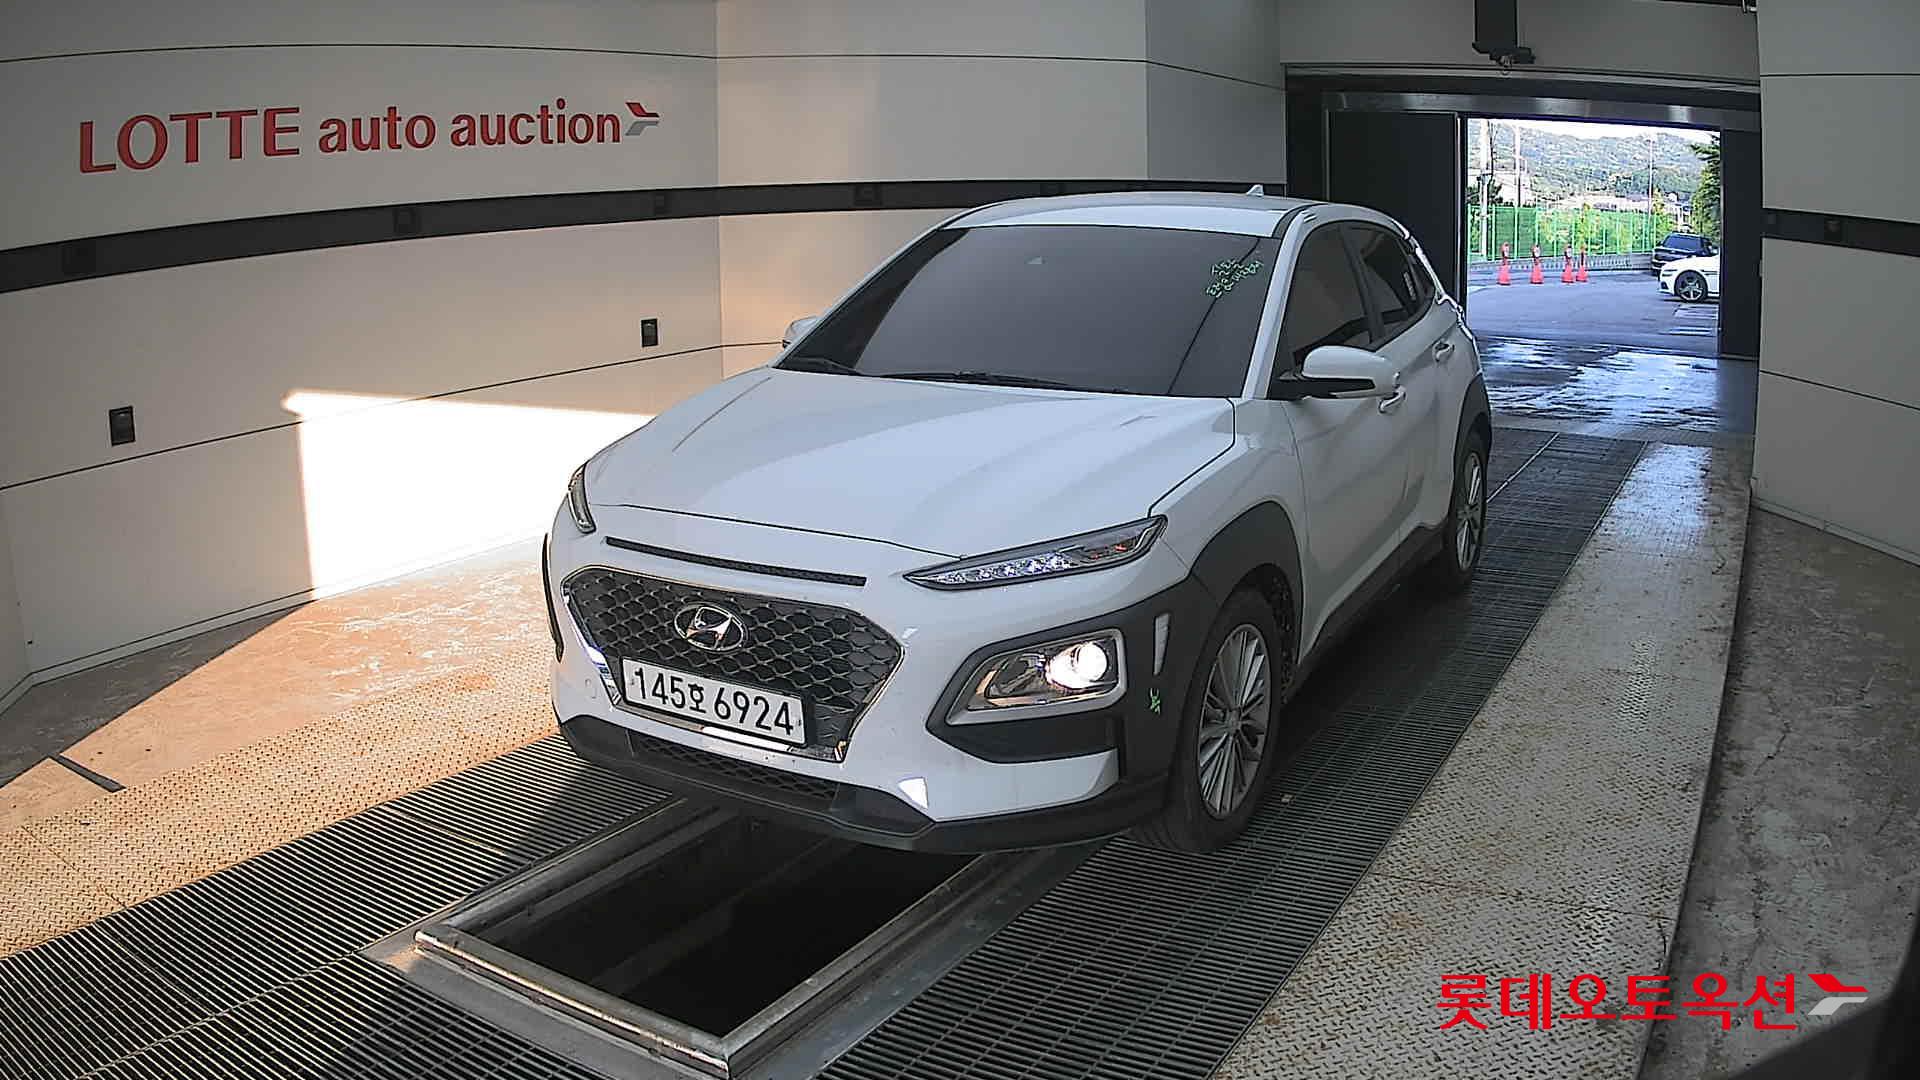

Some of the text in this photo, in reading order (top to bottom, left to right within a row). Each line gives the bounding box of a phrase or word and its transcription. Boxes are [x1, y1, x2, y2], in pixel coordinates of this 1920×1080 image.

[80, 97, 621, 174] LOTTE auto auction
[634, 667, 794, 735] 145호 6924
